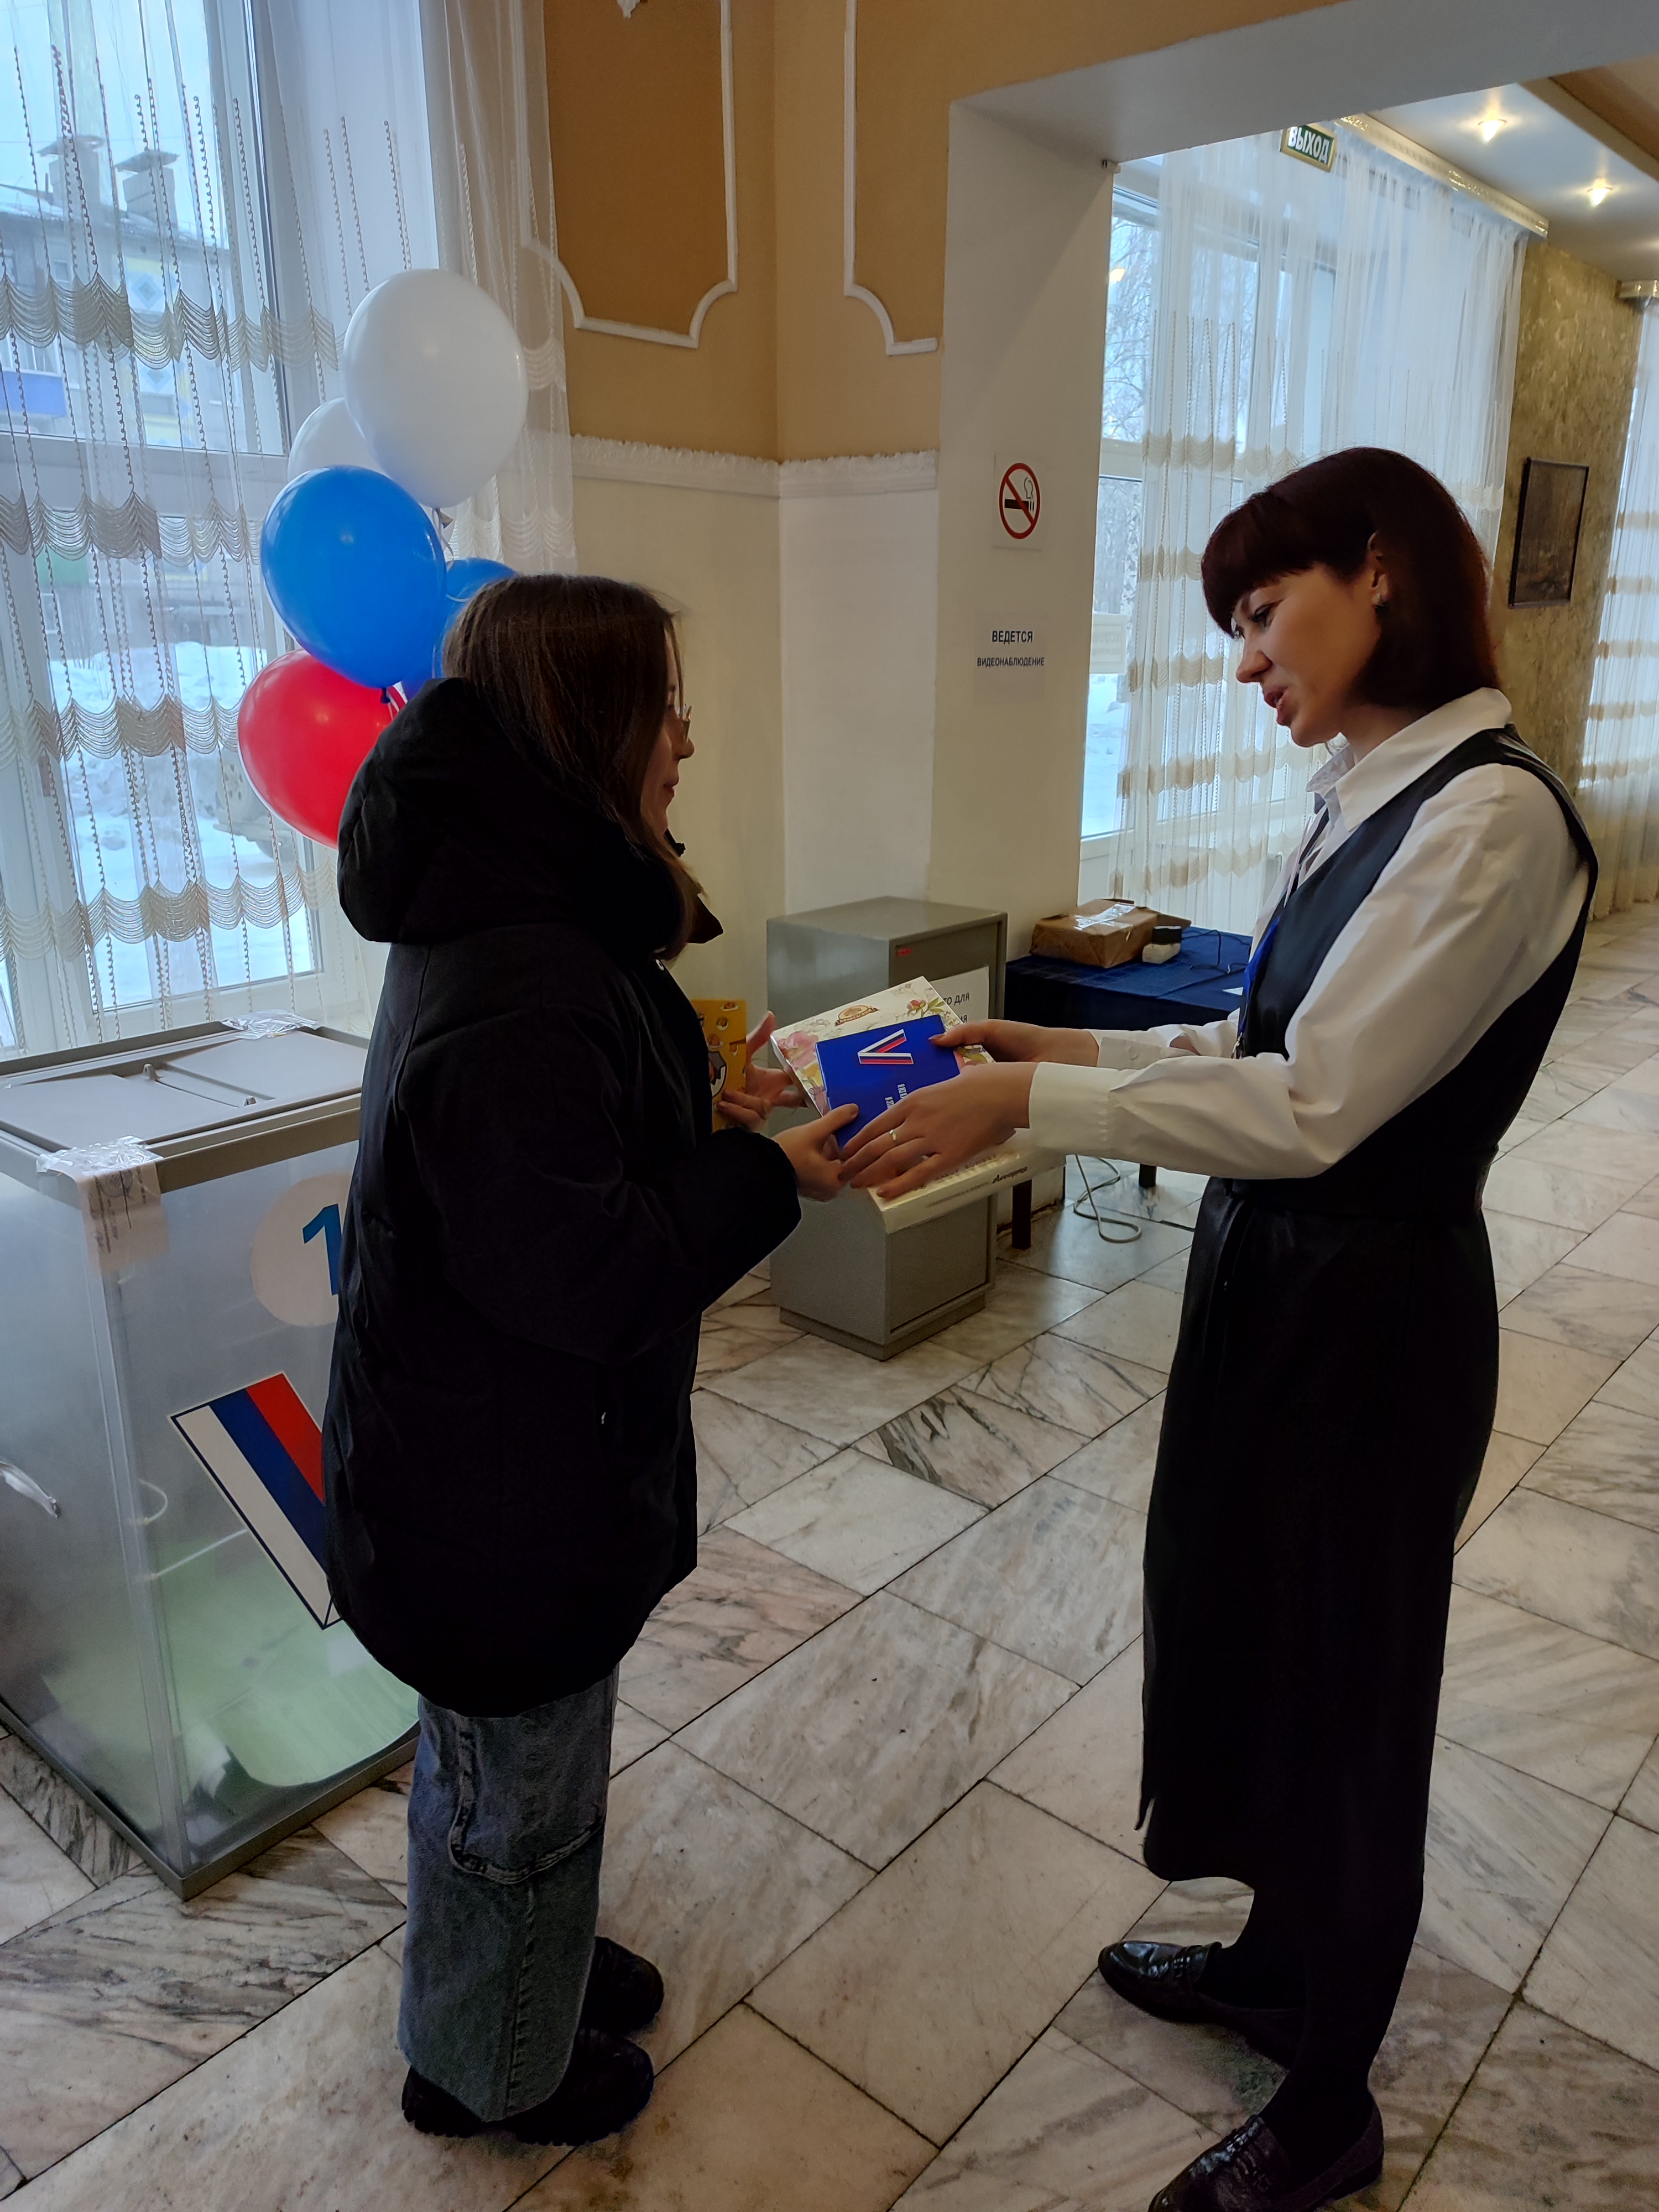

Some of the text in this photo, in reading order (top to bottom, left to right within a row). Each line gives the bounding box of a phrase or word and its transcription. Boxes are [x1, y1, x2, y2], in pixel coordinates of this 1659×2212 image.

[1288, 126, 1330, 164] ВЫХОД
[992, 630, 1033, 644] ВЕДЕТСЯ
[977, 656, 1045, 667] ВИДЕОНАБЛЮДЕНИЕ
[302, 1203, 342, 1296] 1
